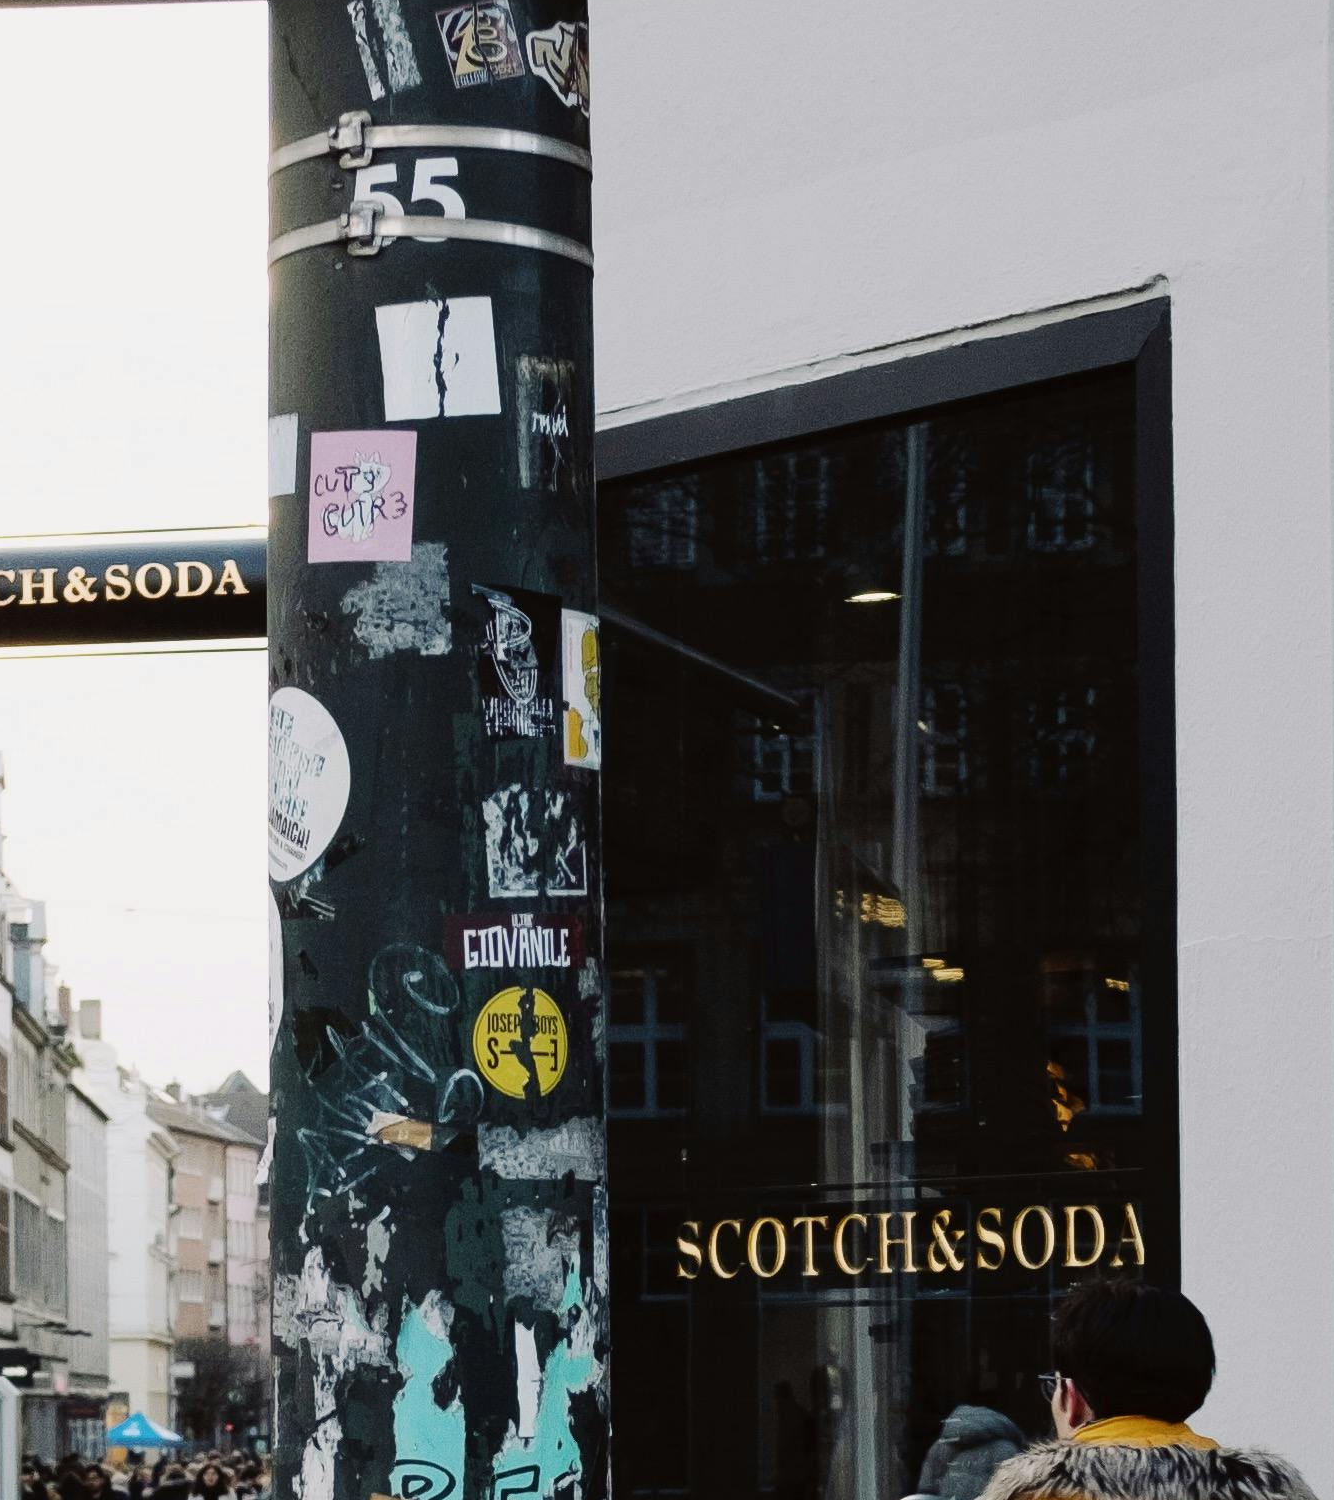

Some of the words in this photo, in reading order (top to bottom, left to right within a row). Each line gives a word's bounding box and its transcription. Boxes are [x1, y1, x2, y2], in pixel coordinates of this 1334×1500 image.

[353, 156, 466, 248] 55
[463, 925, 571, 969] GIOVANILE
[486, 1012, 521, 1035] JOSEP
[675, 1201, 1146, 1280] SCOTCH&SODA
